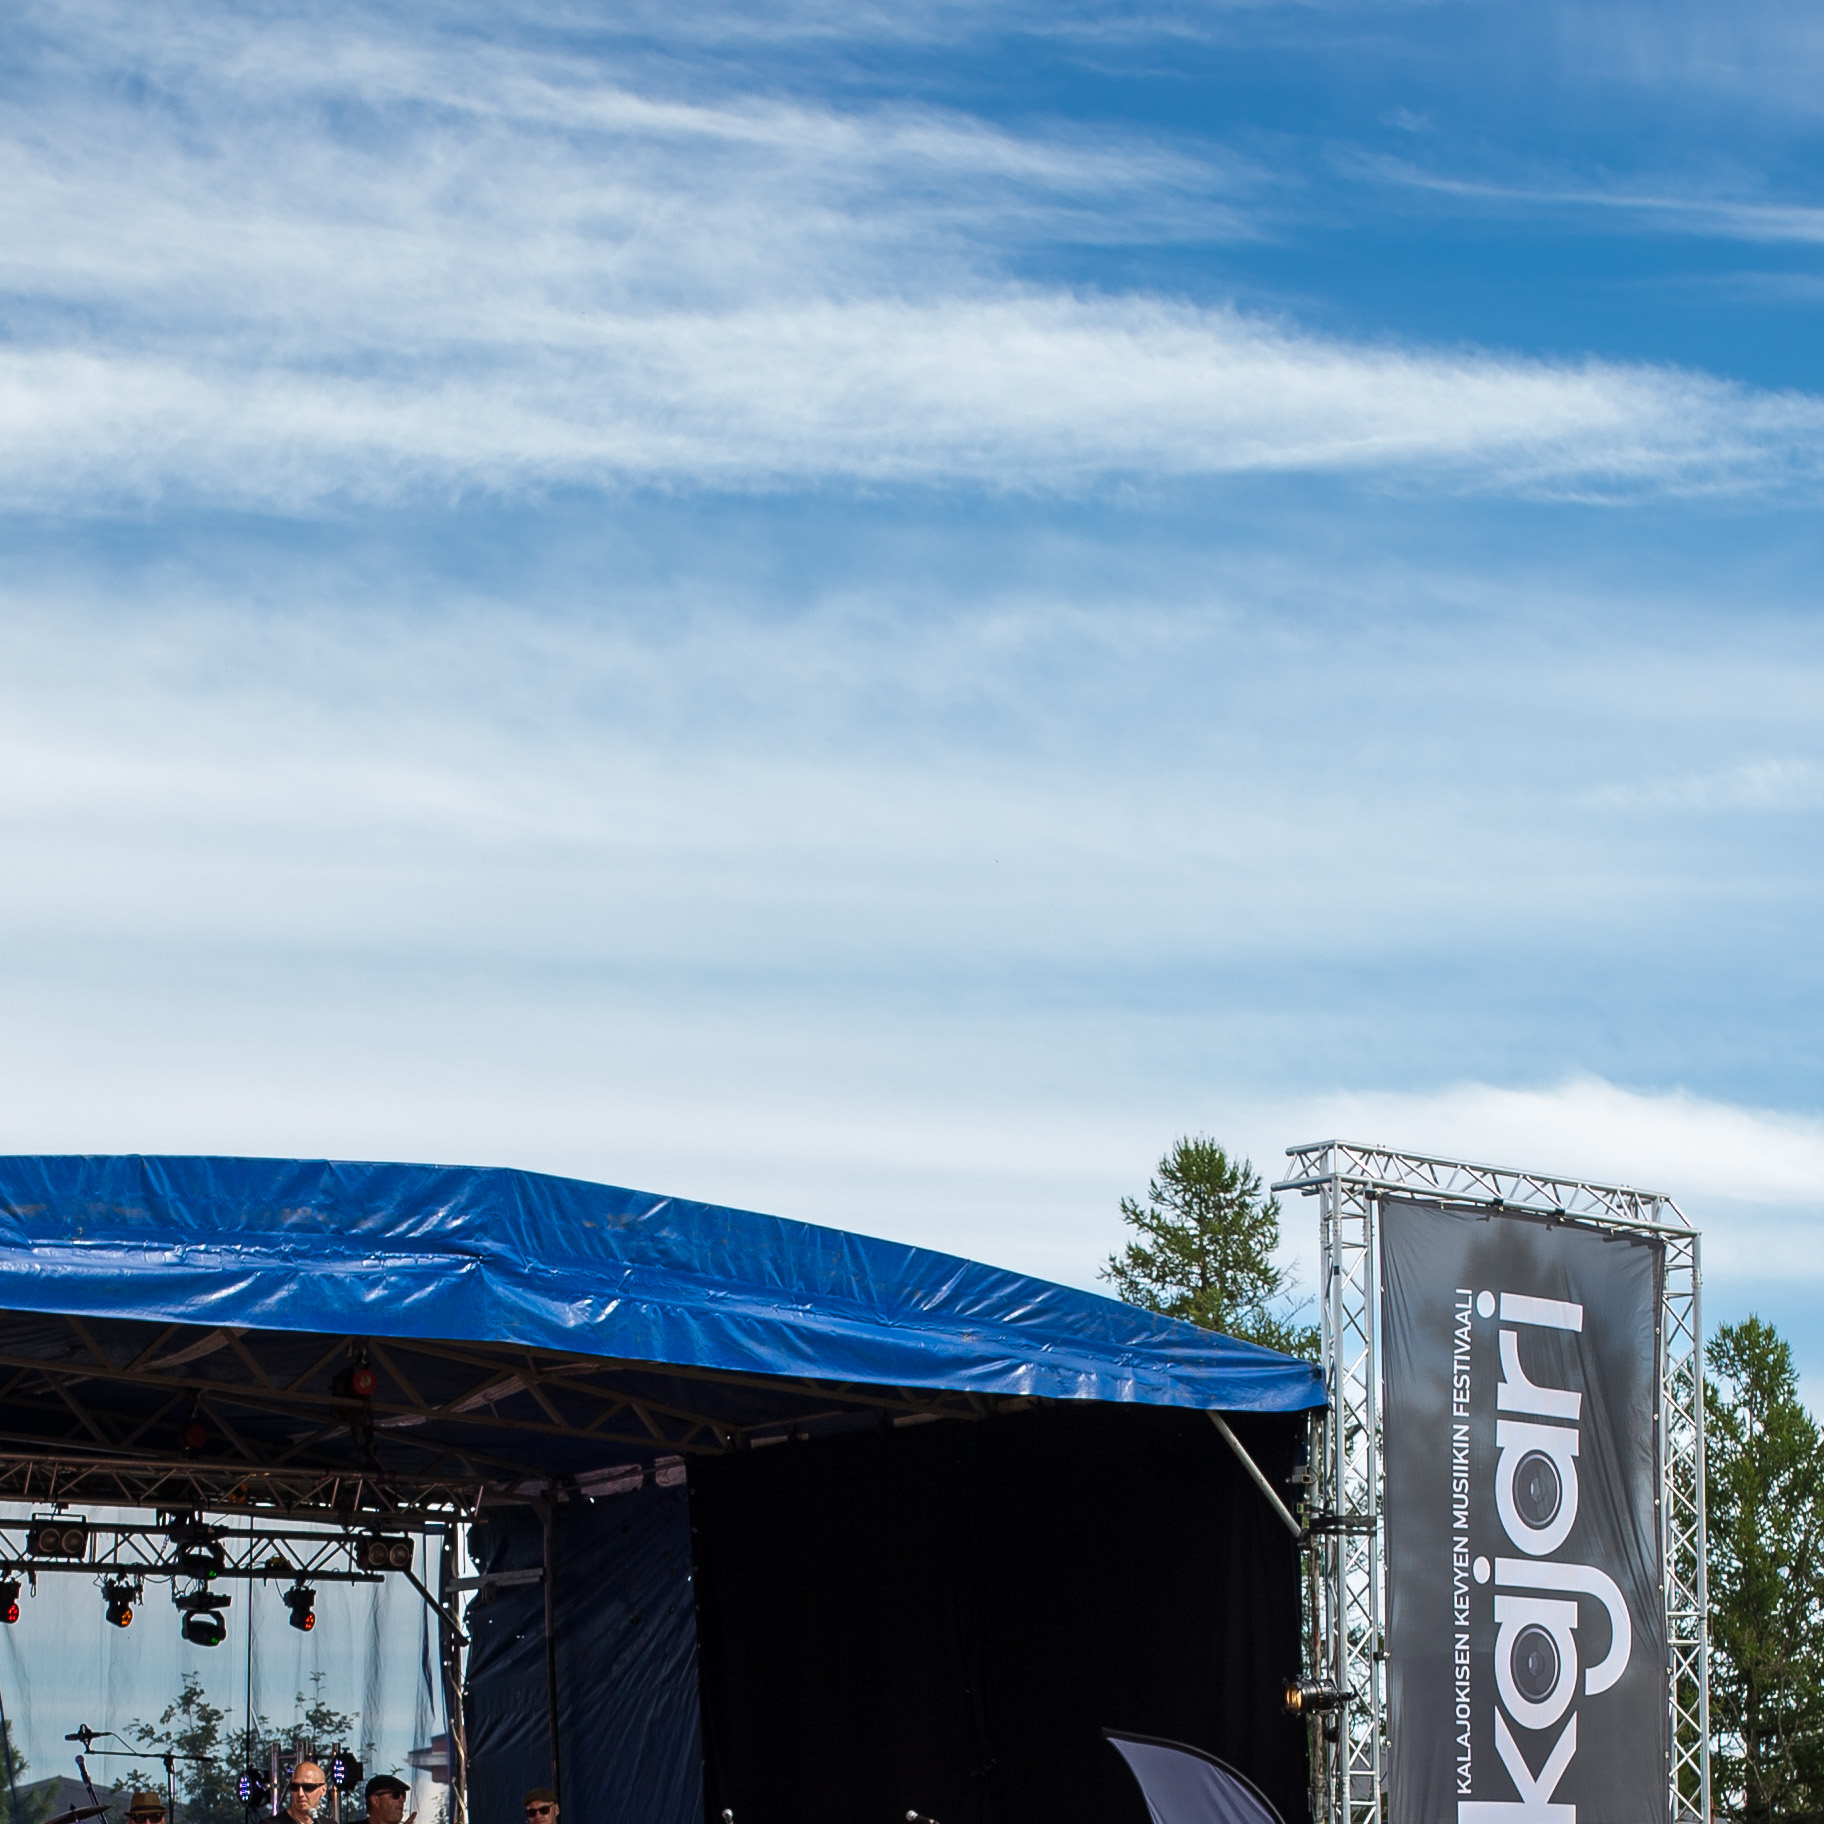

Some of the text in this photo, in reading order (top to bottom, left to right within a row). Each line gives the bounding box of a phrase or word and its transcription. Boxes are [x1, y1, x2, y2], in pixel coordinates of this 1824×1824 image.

[1452, 1288, 1473, 1794] KALAJOKISEN KEVYEN MUSIIKIN FESTIVAALI
